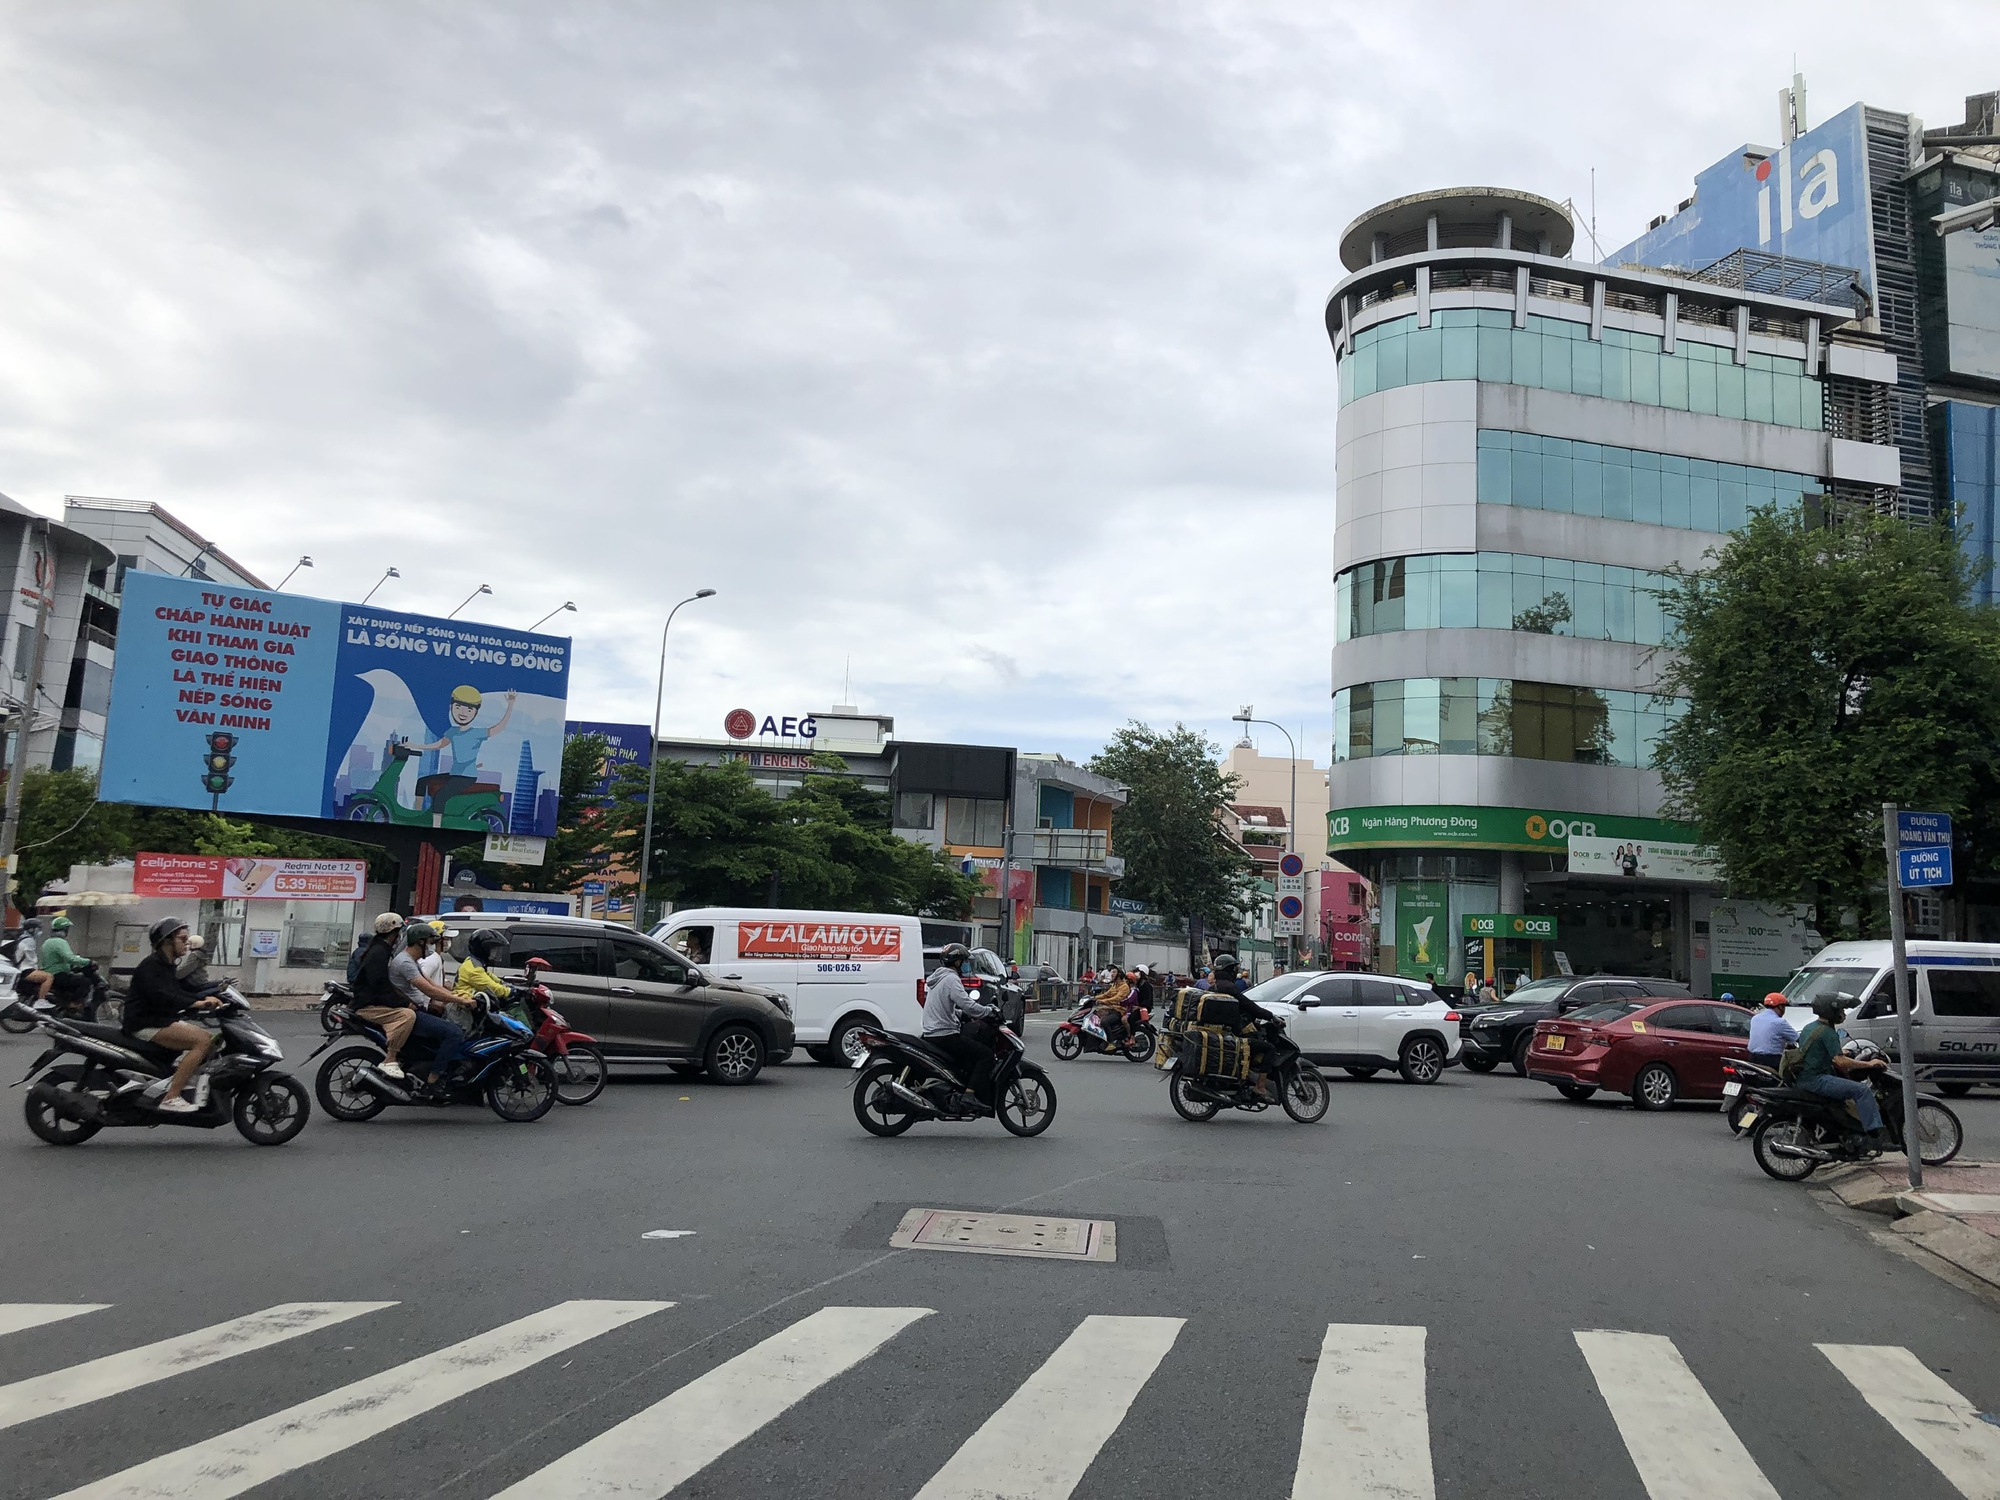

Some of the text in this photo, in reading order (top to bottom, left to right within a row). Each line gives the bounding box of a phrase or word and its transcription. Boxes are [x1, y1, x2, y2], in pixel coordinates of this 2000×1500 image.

[1755, 145, 1839, 246] ila
[1949, 181, 1962, 196] ila
[202, 592, 272, 614] TỰ GIÁC
[155, 606, 311, 640] CHẤP HÀNH LUẬT
[168, 628, 295, 655] KHI THAM GIA
[347, 616, 369, 626] XÂY
[371, 619, 402, 631] DỰNG
[404, 623, 425, 635] NẾP
[427, 626, 456, 639] SỐNG
[504, 640, 528, 650] GIAO
[531, 643, 565, 655] THÔNG
[347, 628, 563, 672] LÀ SỐNG VÌ CỘNG ĐỒNG
[171, 649, 288, 674] GIAO THÔNG
[173, 668, 282, 693] LÀ THỂ HIỆN
[179, 687, 272, 711] NẾP SỐNG
[176, 709, 271, 730] VĂN MINH
[759, 716, 817, 738] AEG
[619, 748, 638, 760] PHÁP
[1330, 816, 1478, 837] OCB Ngân Hàng Phương Đông
[1549, 819, 1596, 838] OCB
[285, 862, 350, 871] Redmi Note 12
[1911, 852, 1939, 863] ĐƯỜNG
[1909, 865, 1942, 882] ÚT TỊCH
[276, 878, 306, 889] 5.39
[308, 883, 327, 891] Triệu
[520, 903, 536, 914] TIẾNG
[537, 906, 549, 915] ANH
[1112, 900, 1143, 911] NEW
[1478, 919, 1494, 930] OCB
[1526, 920, 1551, 932] OCB
[766, 924, 900, 946] LALAMOVE
[801, 944, 816, 952] Giao
[817, 964, 861, 972] 50G-026.52
[1938, 1040, 1999, 1052] SOLATI
